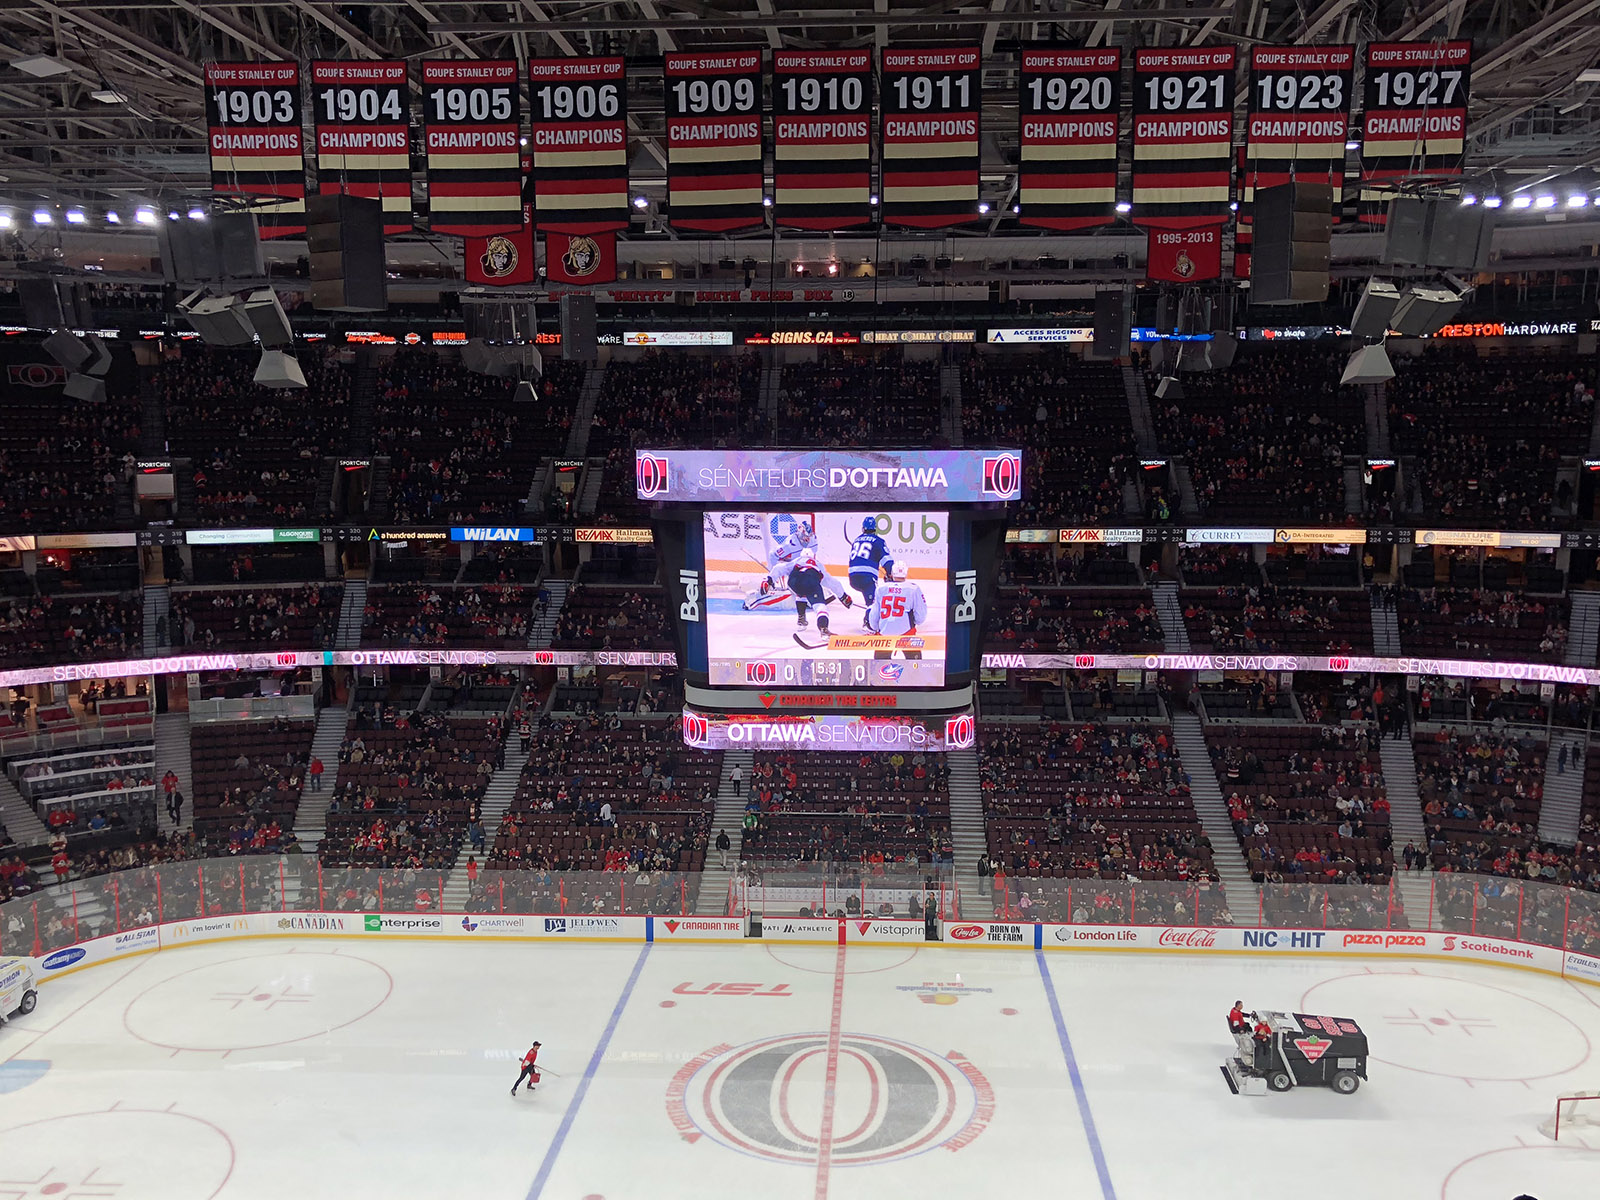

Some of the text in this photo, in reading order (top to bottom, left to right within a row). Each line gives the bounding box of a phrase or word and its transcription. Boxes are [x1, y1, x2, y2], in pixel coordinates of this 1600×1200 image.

[778, 56, 867, 67] COUPE STANLEY CUP
[886, 54, 977, 66] COUPE STANLEY CUP
[1026, 55, 1116, 67] COUPE STANLEY CUP
[1140, 54, 1231, 67] COUPE STANLEY CUP
[1256, 54, 1349, 65] COUPE STANLEY CUP
[1372, 48, 1467, 61] COUPE STANLEY CUP
[533, 64, 621, 76] COUPE STANLEY CUP
[668, 56, 758, 70] COUPE STANLEY CUP
[208, 69, 295, 80] COUPE STANLEY CUP
[316, 67, 403, 79] COUPE STANLEY CUP
[426, 66, 514, 78] COUPE STANLEY CUP
[672, 78, 755, 113] 1909
[782, 78, 863, 111] 1910
[893, 76, 970, 109] 1911
[1028, 76, 1112, 111] 1920
[1145, 76, 1224, 110] 1921
[1258, 75, 1343, 109] 1923
[1374, 71, 1462, 106] 1927
[213, 90, 294, 123] 1903
[321, 88, 402, 121] 1904
[430, 88, 512, 121] 1905
[536, 84, 619, 119] 1906
[670, 122, 759, 141] CHAMPIONS
[778, 122, 867, 139] CHAMPIONS
[886, 119, 976, 137] CHAMPIONS
[1024, 121, 1115, 139] CHAMPIONS
[1137, 120, 1229, 139] CHAMPIONS
[1251, 120, 1344, 138] CHAMPIONS
[1367, 115, 1462, 134] CHAMPIONS
[212, 133, 298, 150] CHAMPIONS
[320, 132, 406, 149] CHAMPIONS
[429, 131, 516, 148] CHAMPIONS
[536, 128, 623, 145] CHAMPIONS
[1156, 232, 1214, 245] 1995-2013
[751, 290, 794, 301] PRESS
[804, 290, 834, 301] BOX
[771, 331, 834, 344] SIGNS.CA
[1504, 324, 1577, 336] HARDWARE
[698, 463, 949, 488] SÉNATEURS D'OTTAWA
[417, 532, 447, 540] answers
[463, 528, 520, 541] WiLAN
[576, 530, 614, 541] RE/MAX
[1060, 529, 1100, 541] RE/MAX
[1202, 532, 1244, 540] CURREY
[680, 569, 699, 623] Bell
[955, 569, 977, 623] Bell
[880, 596, 907, 620] 55
[835, 638, 892, 648] NHL.COM/VOTE
[152, 654, 237, 674] D'OTTAWA
[352, 652, 497, 665] OTTAWA SENATORS
[1146, 656, 1298, 670] OTTAWA SENATORS
[784, 662, 865, 681] 0 15:31 0
[1494, 663, 1587, 683] D'OTTAWA
[780, 695, 897, 706] CANADIAN TIRE CENTRE
[728, 724, 926, 743] OTTAWA SENATORS
[204, 923, 225, 932] lovin'
[225, 922, 231, 930] it
[291, 916, 344, 930] CANADIAN
[371, 918, 441, 929] enterprise
[682, 922, 740, 931] CANADIAN TIRE
[872, 924, 925, 937] vistaprin
[990, 924, 1021, 934] BORN ON
[987, 932, 1023, 942] THE FARM
[1074, 930, 1138, 941] London Life
[1291, 931, 1325, 948] HIT
[1343, 934, 1426, 949] pizza pizza
[1460, 940, 1534, 960] Scotiabank
